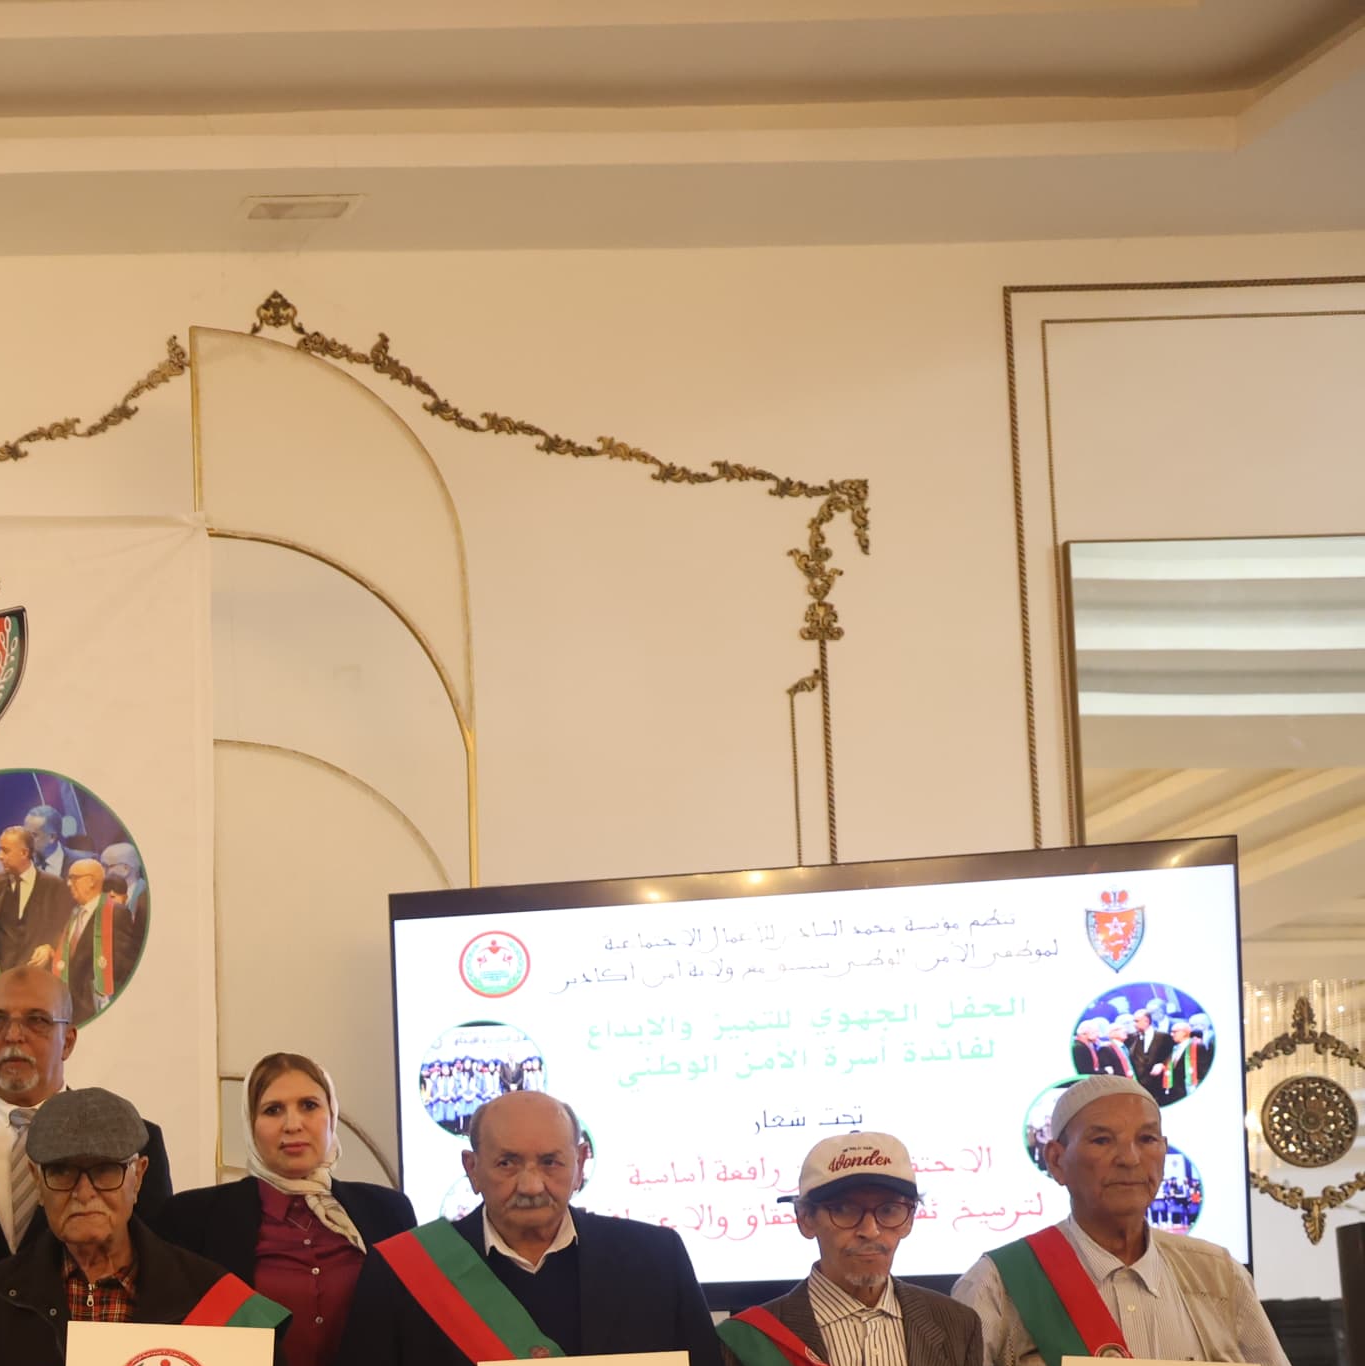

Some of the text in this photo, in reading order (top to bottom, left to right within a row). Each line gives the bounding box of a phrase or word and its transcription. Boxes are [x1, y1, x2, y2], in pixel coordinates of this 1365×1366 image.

[713, 1008, 792, 1041] للتميز
[810, 1002, 918, 1036] الجهوي
[936, 996, 1026, 1031] الحفل
[618, 1036, 996, 1094] لفائدة أسرة الأمن الوطني
[752, 1107, 807, 1135] شعار
[628, 1153, 706, 1191] أساسية
[828, 1149, 893, 1173] Wonder
[951, 1191, 1044, 1232] لترسيخ
